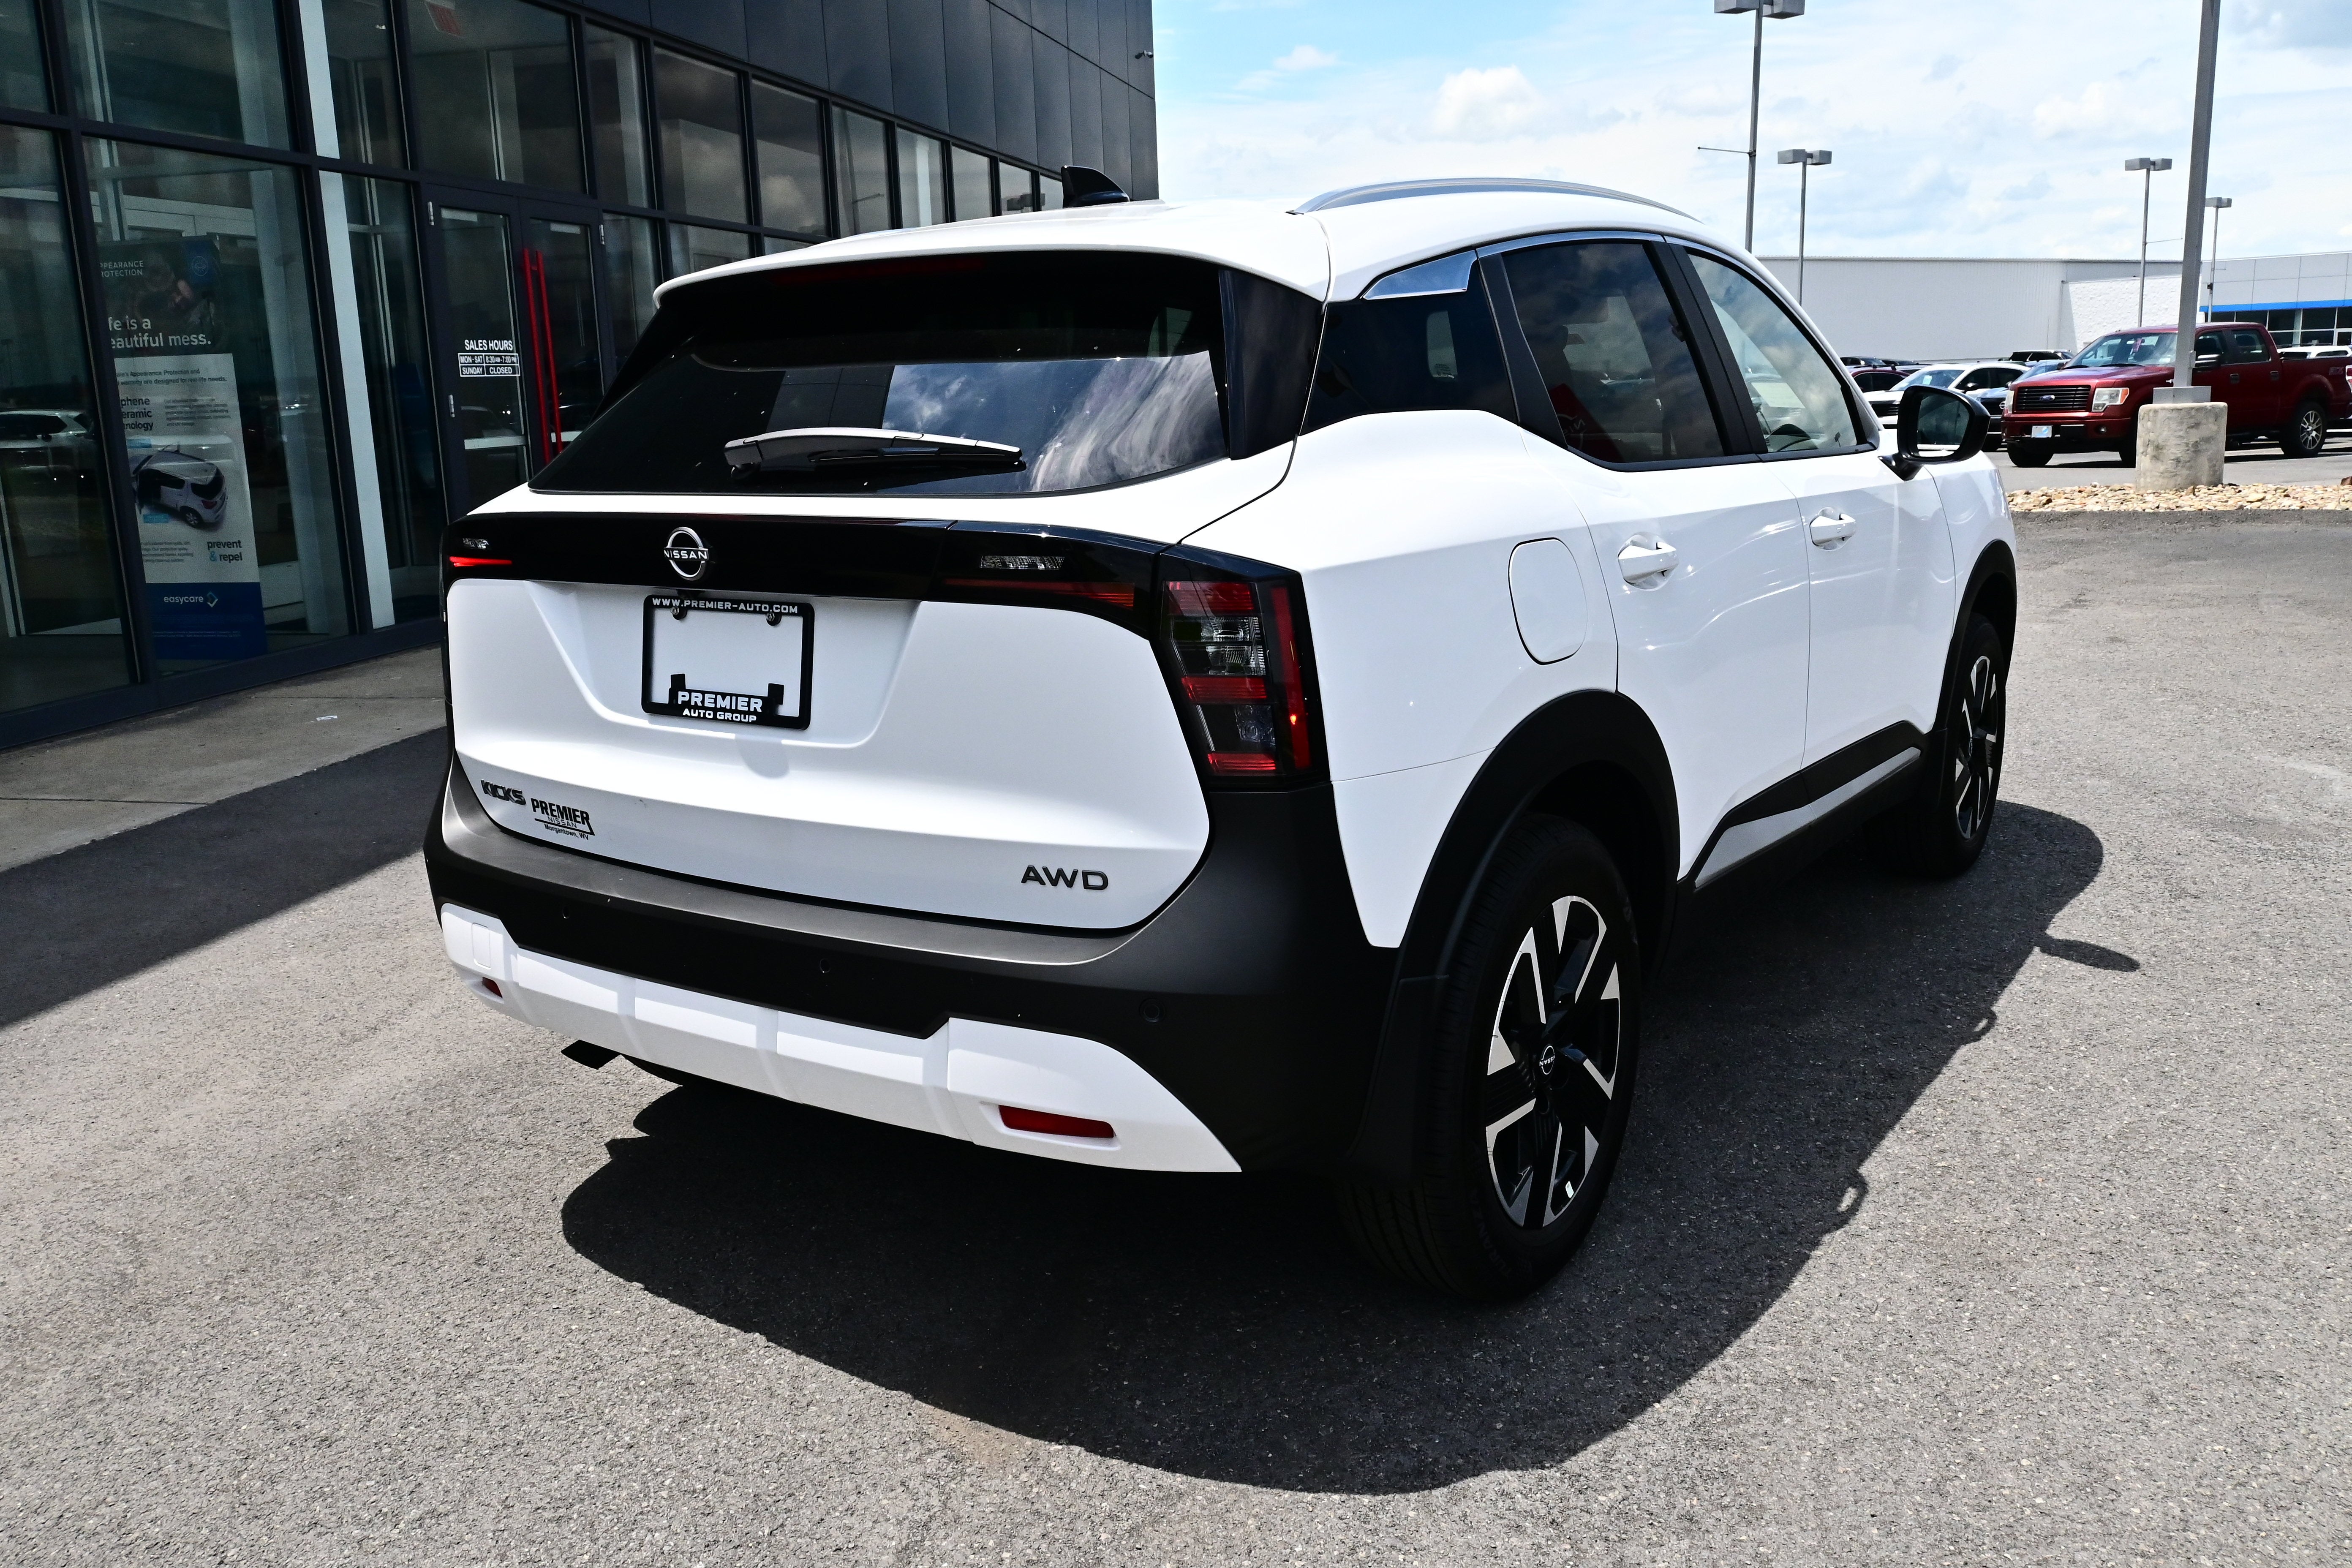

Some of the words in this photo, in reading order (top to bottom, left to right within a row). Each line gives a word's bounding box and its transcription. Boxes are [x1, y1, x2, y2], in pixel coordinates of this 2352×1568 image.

[126, 315, 137, 330] is
[142, 318, 151, 329] a
[169, 334, 211, 346] mess.
[465, 339, 487, 351] SALES
[488, 340, 513, 351] HOURS
[462, 367, 483, 375] SUNDAY
[207, 539, 242, 550] prevent
[219, 552, 243, 563] repel
[664, 550, 708, 559] NISSAN
[163, 595, 204, 604] easycare
[652, 597, 798, 614] WWW.PREMIER-AUTO.COM
[678, 691, 763, 712] PREMIER
[683, 708, 714, 719] AUTO
[716, 711, 757, 723] GROUP
[480, 779, 526, 806] KICKS
[531, 798, 590, 825] PREMIER
[547, 816, 577, 829] NISSAN
[544, 823, 579, 839] Morgantown,
[579, 832, 589, 841] WV
[1021, 865, 1109, 891] AWD
